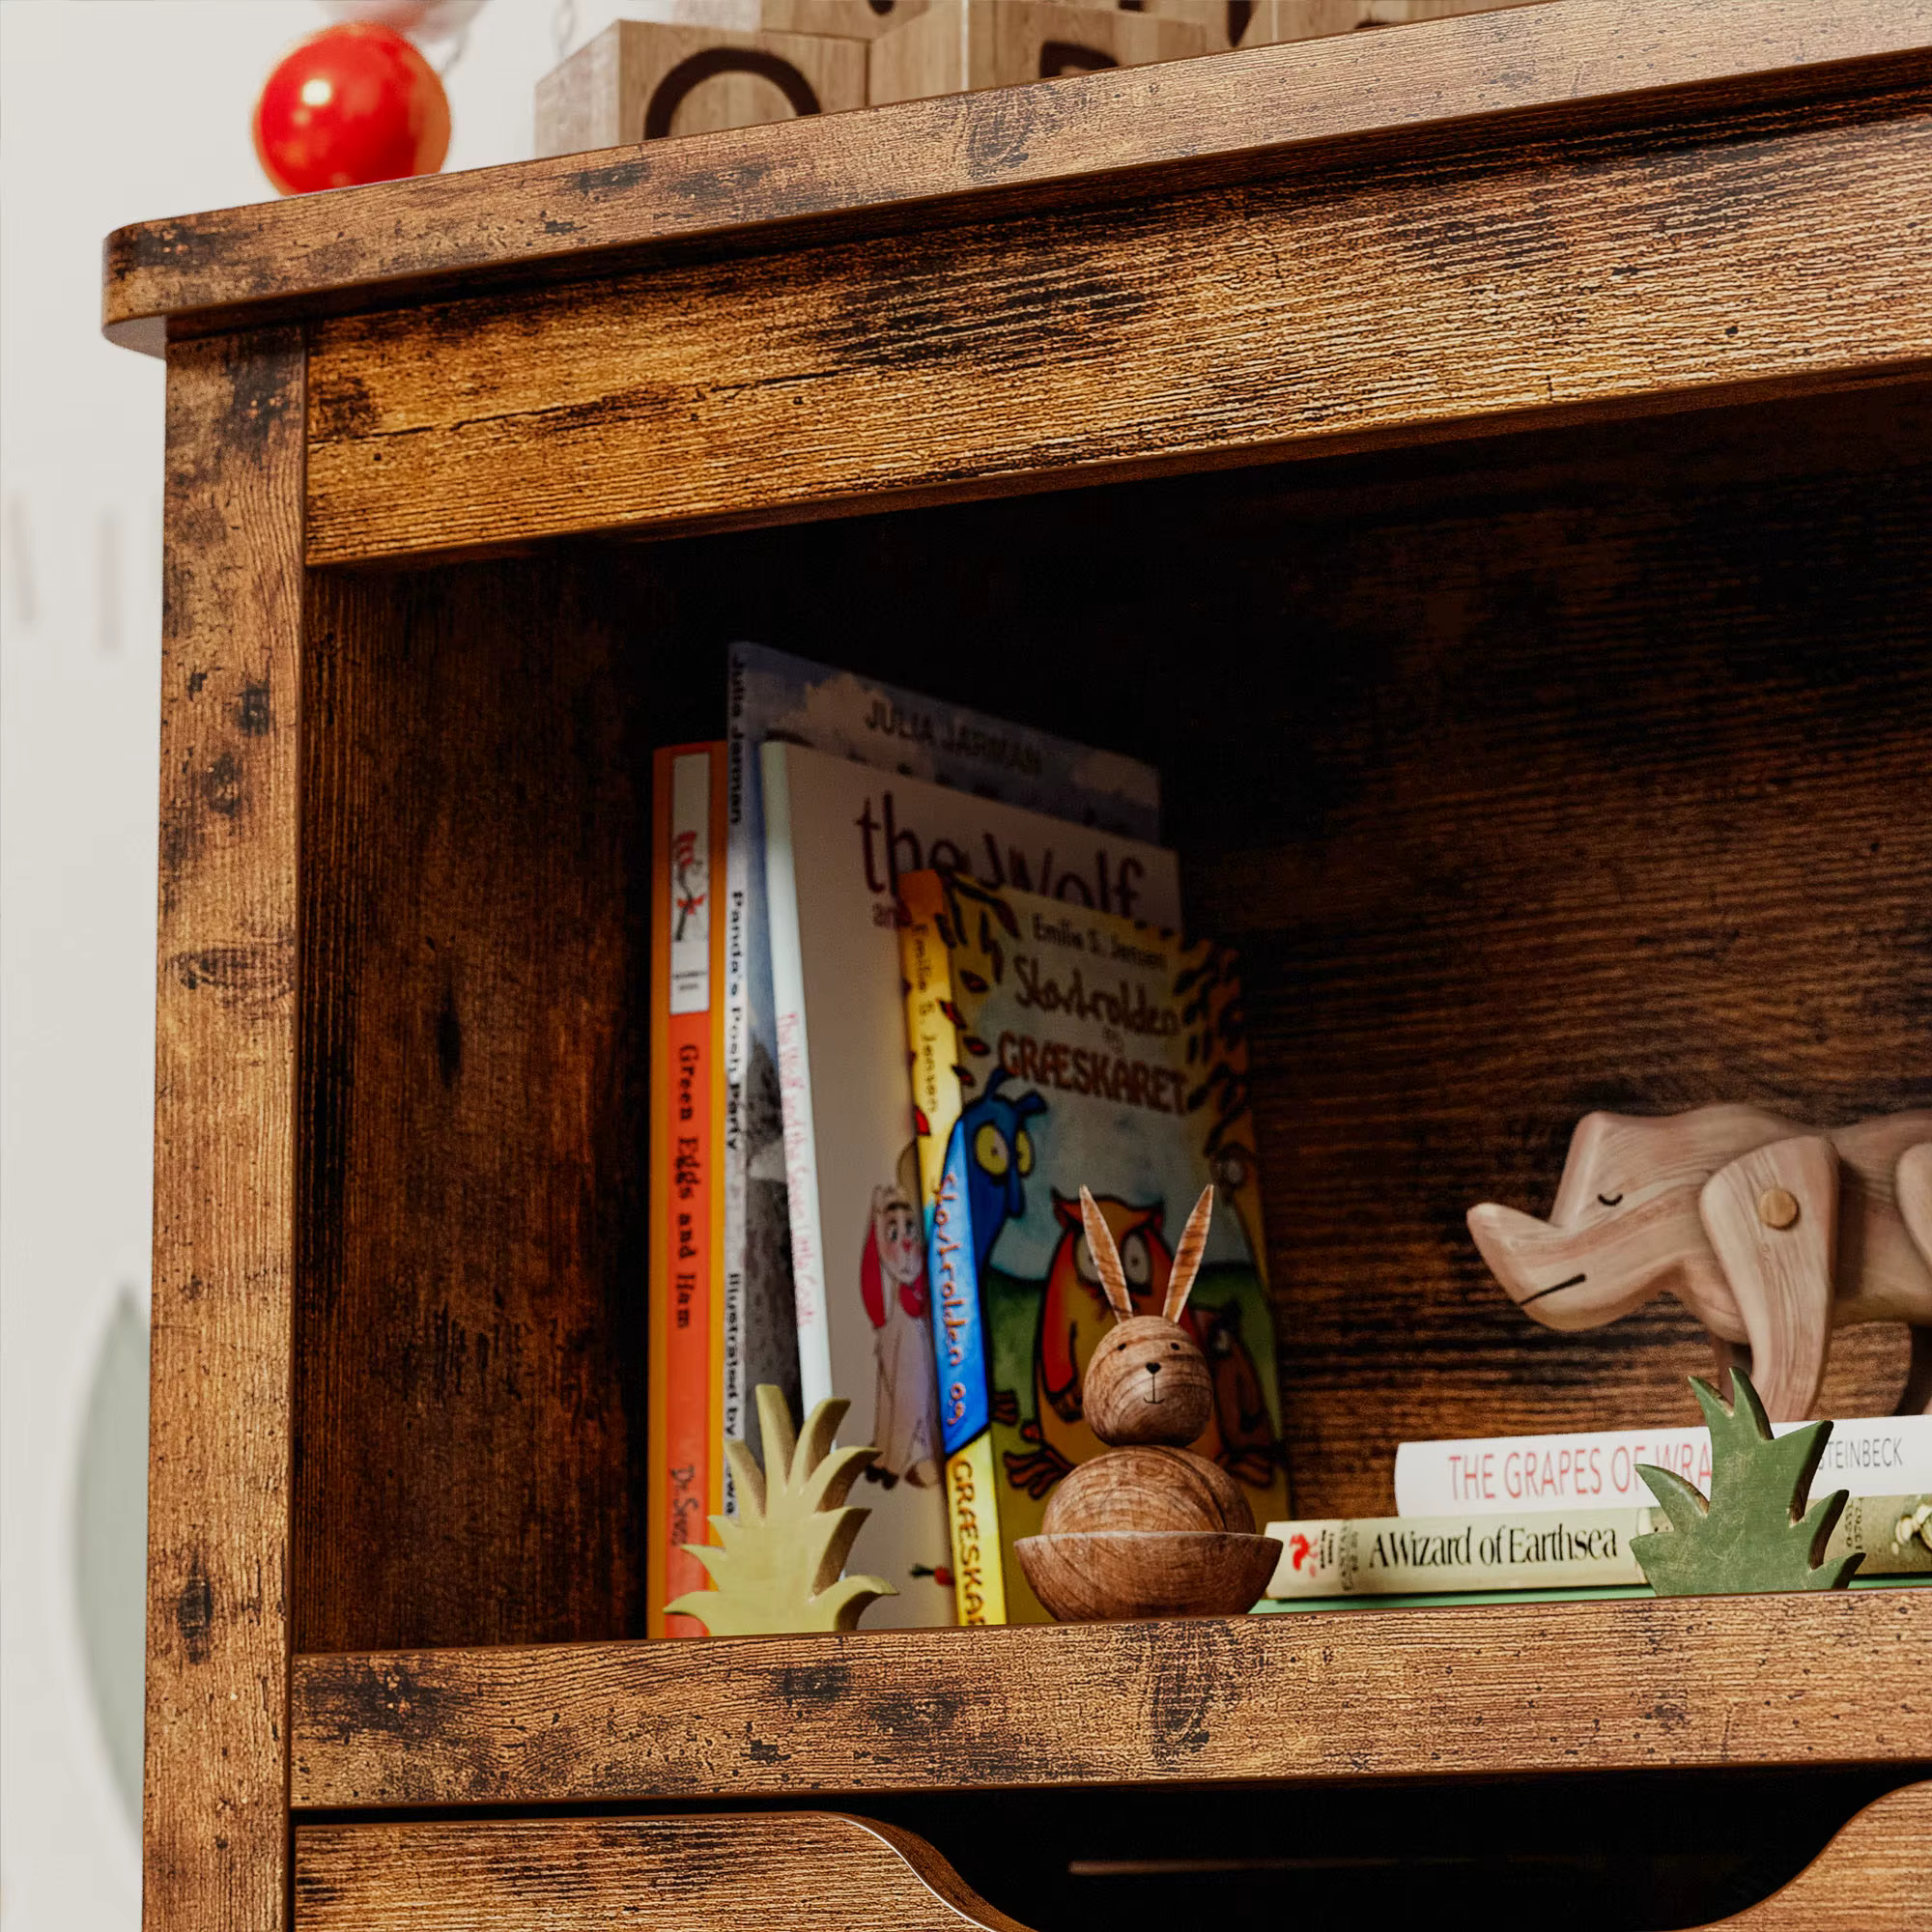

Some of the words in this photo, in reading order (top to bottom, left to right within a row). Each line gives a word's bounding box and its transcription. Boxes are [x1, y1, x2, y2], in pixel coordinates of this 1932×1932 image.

[865, 698, 934, 743] JULIA
[856, 791, 969, 896] the
[678, 1042, 700, 1121] Green
[999, 1031, 1188, 1117] GRÆSKARET
[726, 1082, 741, 1151] Party
[676, 1136, 701, 1202] Eggs
[677, 1212, 698, 1260] and
[676, 1271, 696, 1329] Ham
[1447, 1453, 1495, 1502] THE
[1504, 1448, 1603, 1500] GRAPES
[1611, 1445, 1646, 1493] OF
[1389, 1524, 1472, 1570] Wizard
[1479, 1524, 1508, 1565] of
[1509, 1522, 1618, 1563] Earthsea
